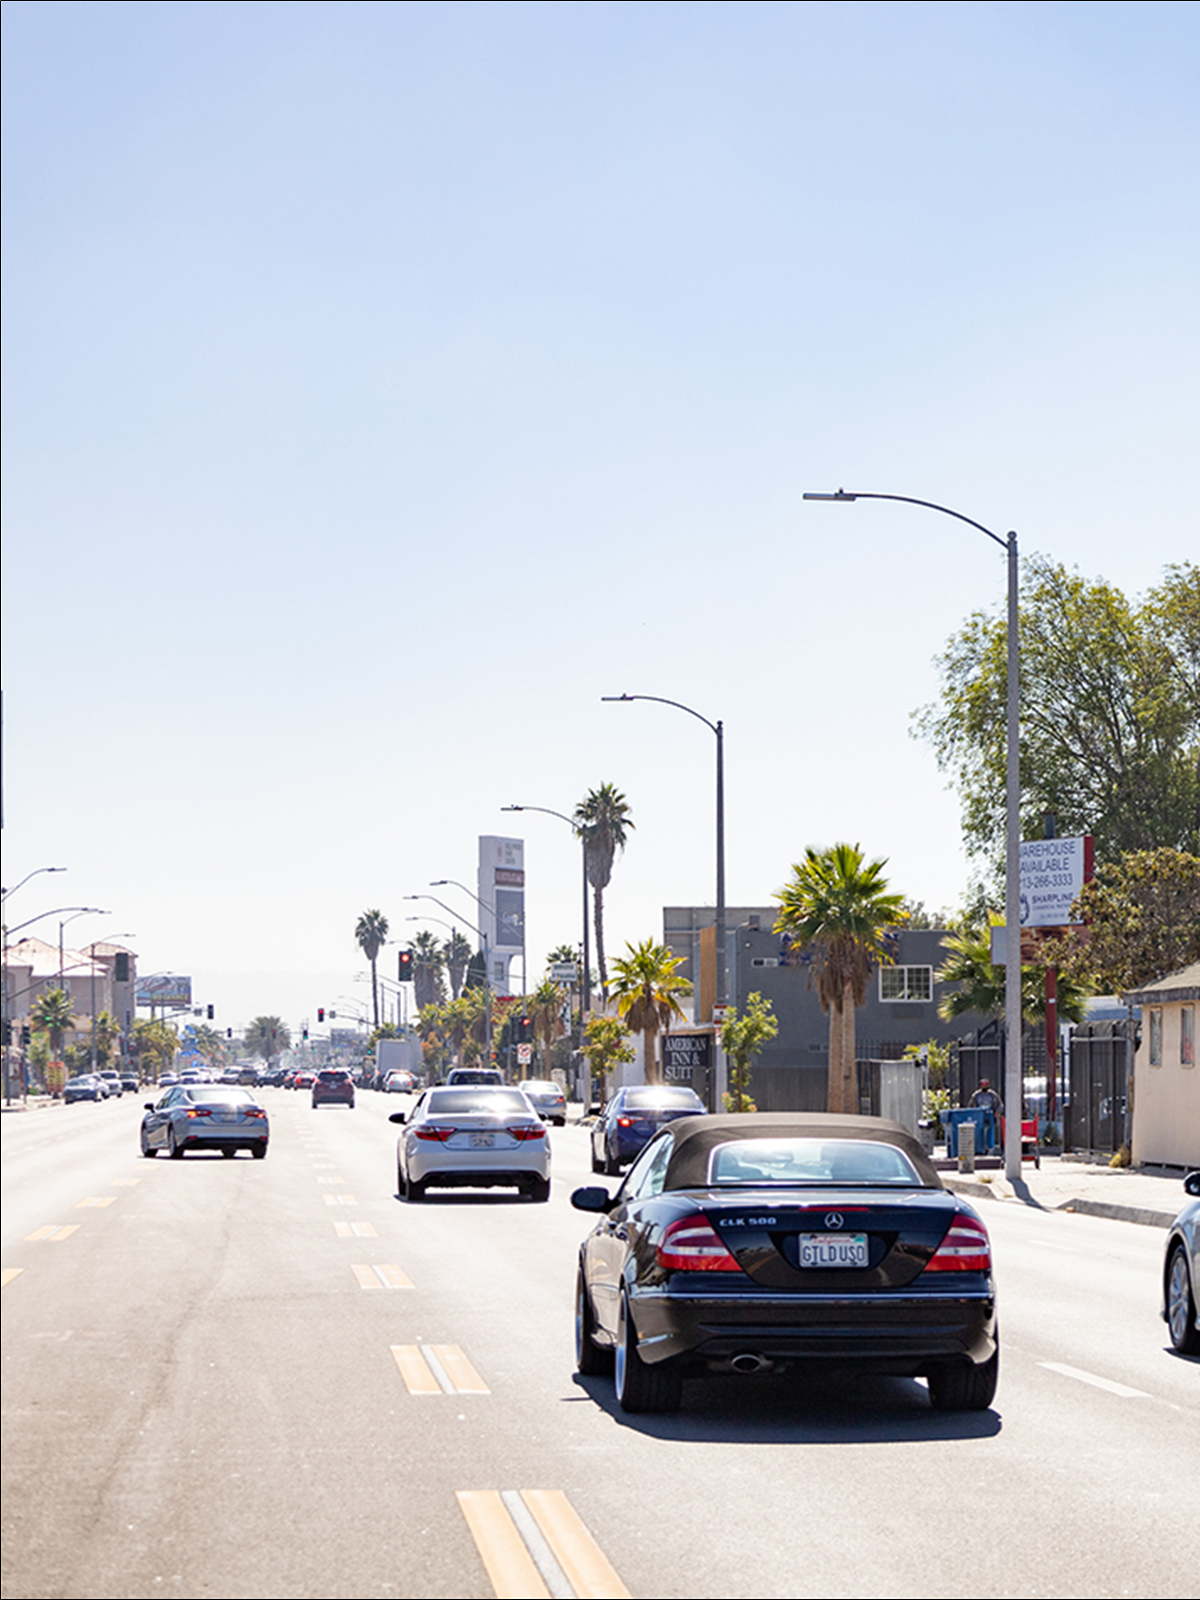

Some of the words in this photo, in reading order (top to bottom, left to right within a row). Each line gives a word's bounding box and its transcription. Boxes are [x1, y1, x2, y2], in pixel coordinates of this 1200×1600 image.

[1020, 841, 1076, 857] AREHOUSE
[1020, 857, 1070, 873] AVAILABLE
[1020, 873, 1073, 889] 13-266-3333
[665, 1037, 707, 1051] AMERICAN
[671, 1052, 691, 1065] INN
[665, 1066, 693, 1080] SUIT
[719, 1218, 745, 1227] CLK
[749, 1217, 777, 1225] 500
[813, 1235, 852, 1245] California
